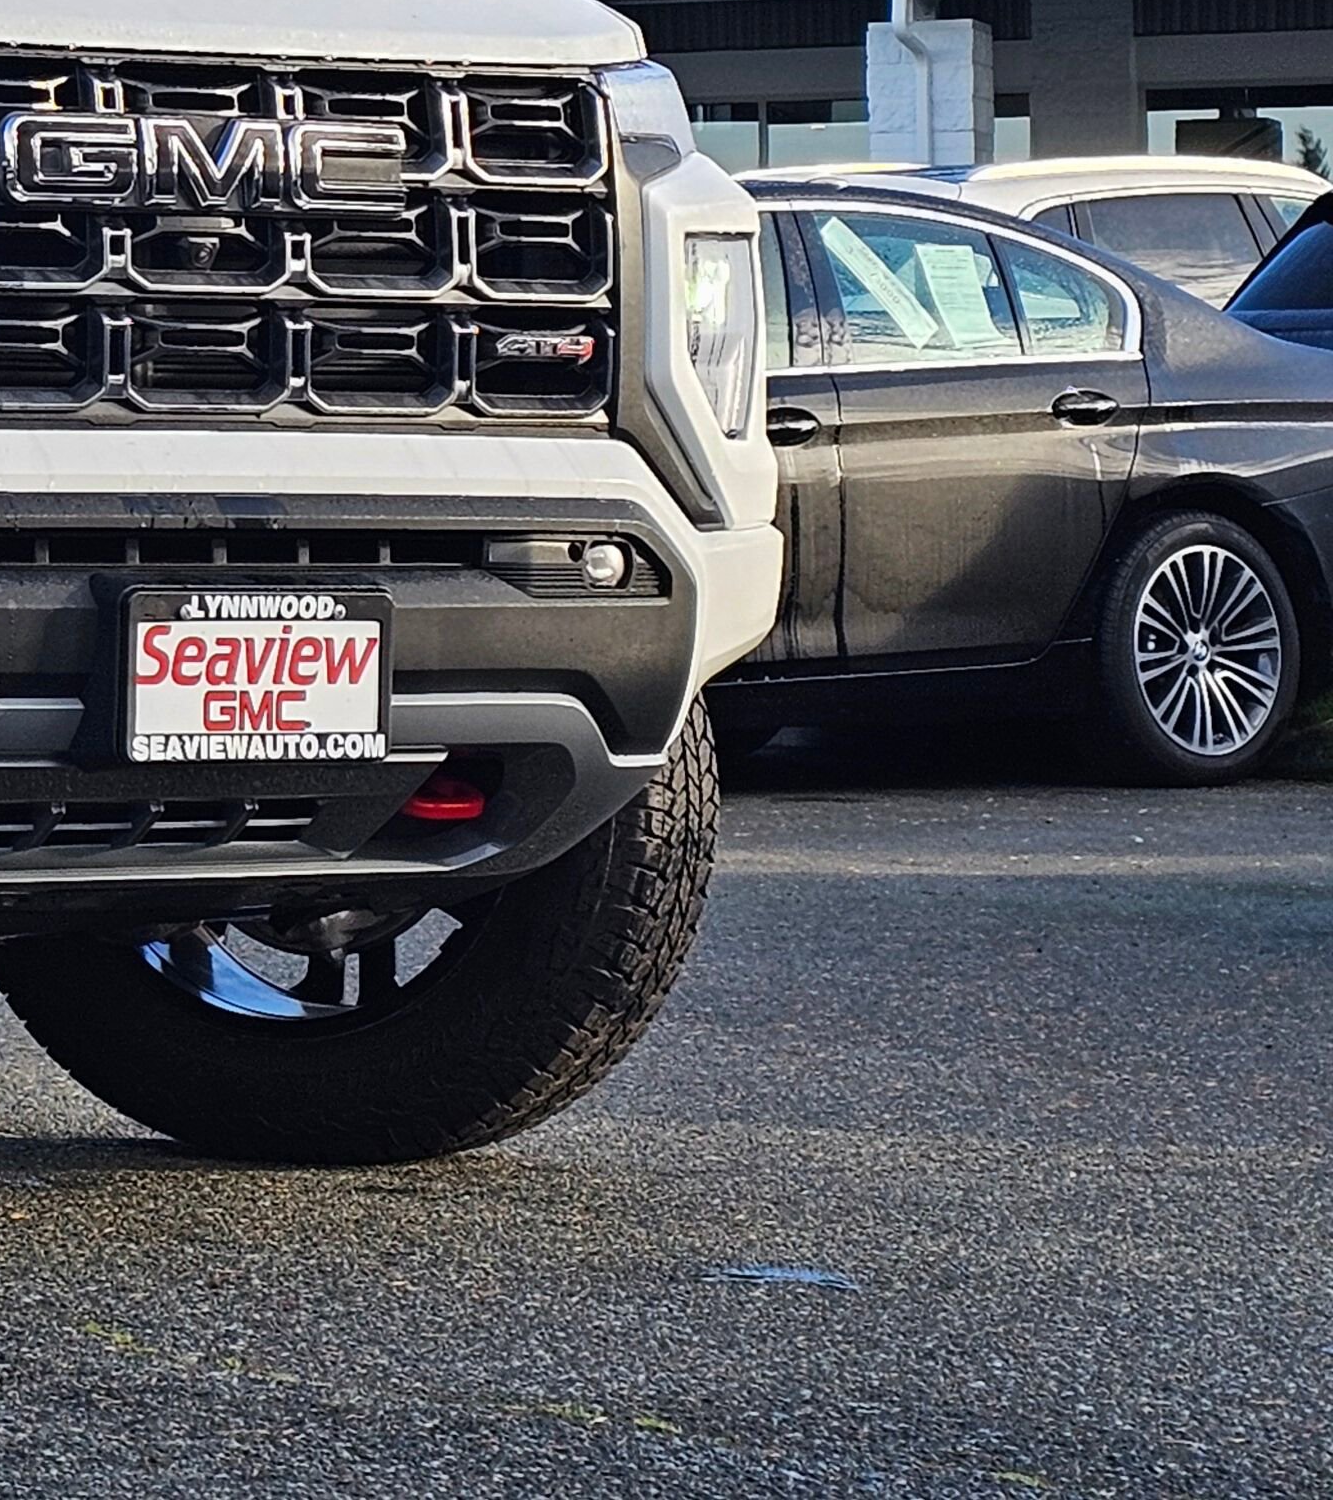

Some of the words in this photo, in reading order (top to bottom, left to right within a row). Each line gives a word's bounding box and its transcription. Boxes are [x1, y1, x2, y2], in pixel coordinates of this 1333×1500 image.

[0, 111, 408, 215] GMC
[190, 595, 335, 619] LYNNWOOD
[134, 624, 378, 686] Seaview
[203, 690, 307, 732] GMC
[132, 733, 385, 762] SEAVIEWAUTO.COM
